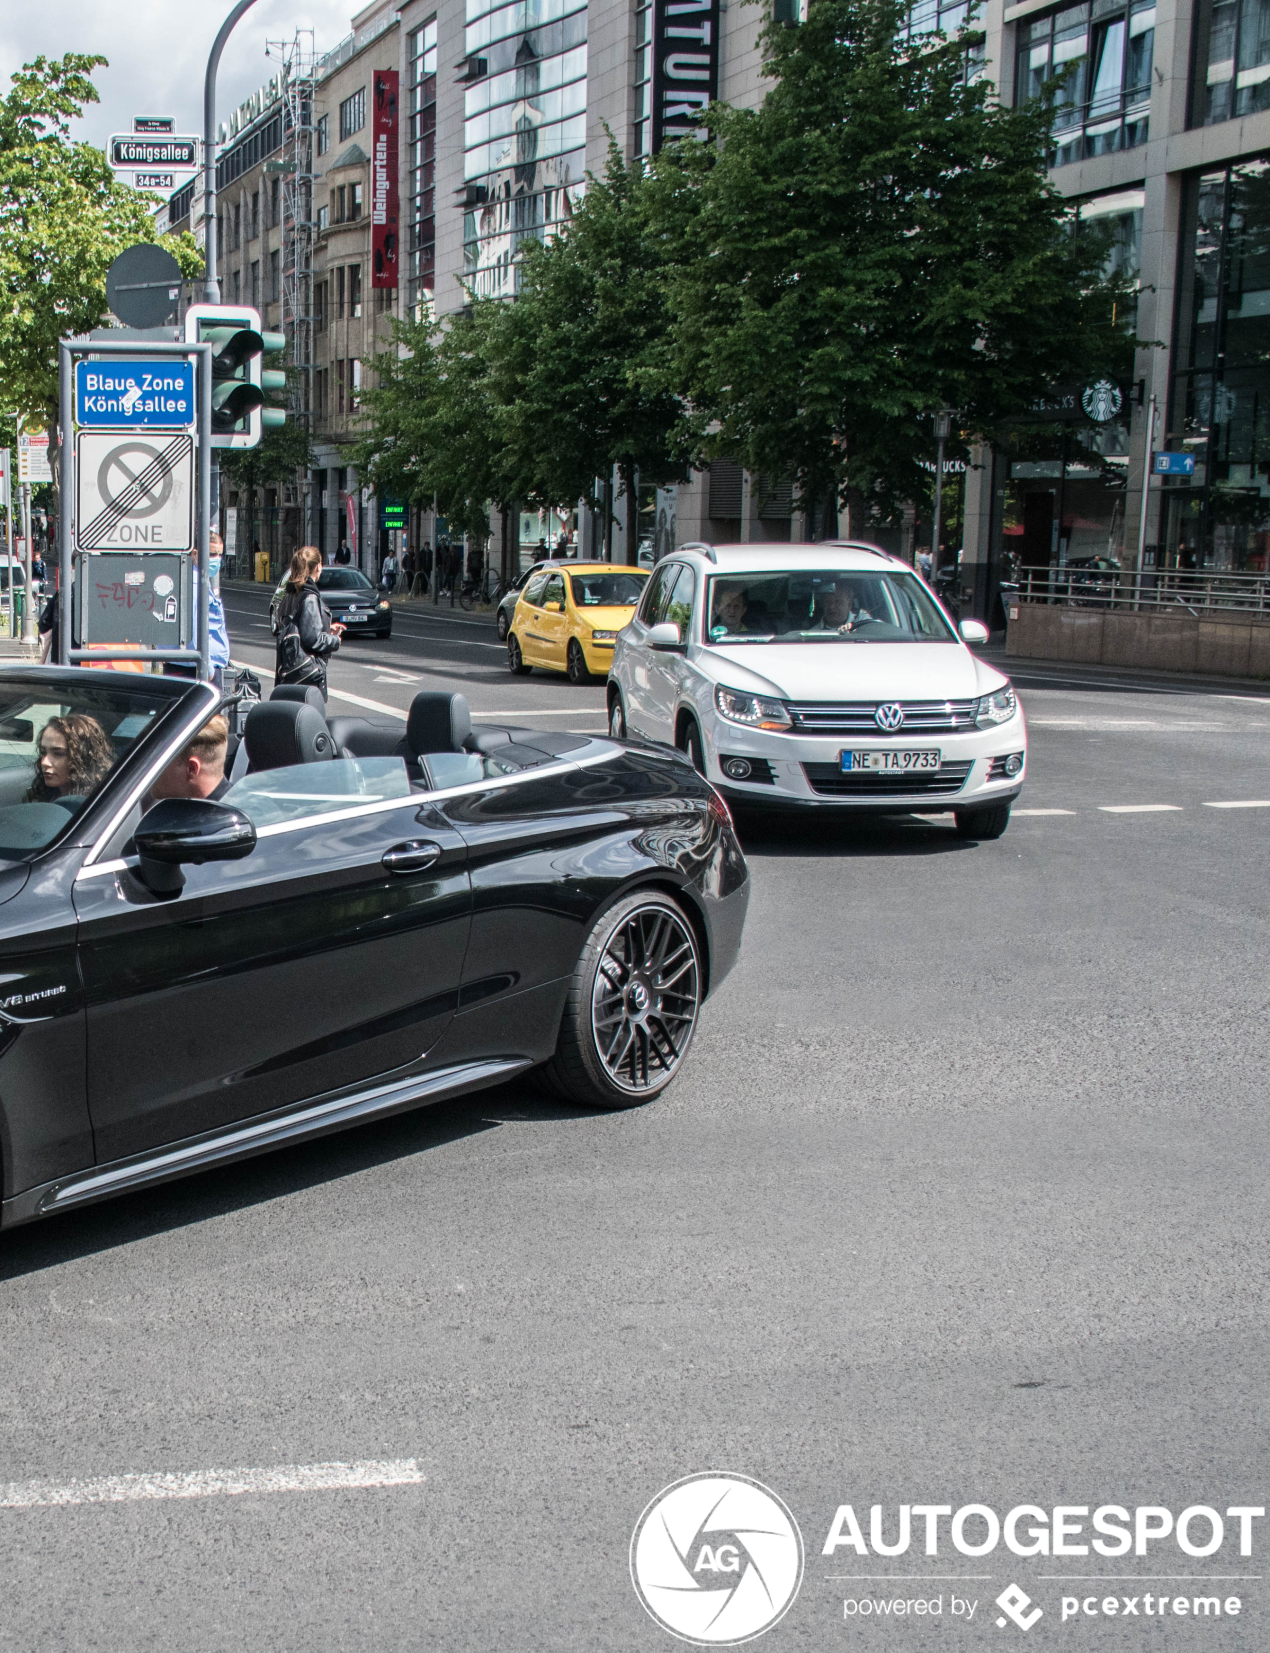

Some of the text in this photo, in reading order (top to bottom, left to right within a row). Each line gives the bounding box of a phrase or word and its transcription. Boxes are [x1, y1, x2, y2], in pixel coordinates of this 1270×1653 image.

[120, 143, 189, 162] Königsallee
[138, 176, 171, 187] 34a-54
[86, 374, 184, 391] Blaue Zone
[84, 396, 187, 416] Königsallee
[106, 525, 163, 543] ZONE
[852, 752, 938, 769] NE TA 9733
[25, 985, 66, 1003] BITURBO
